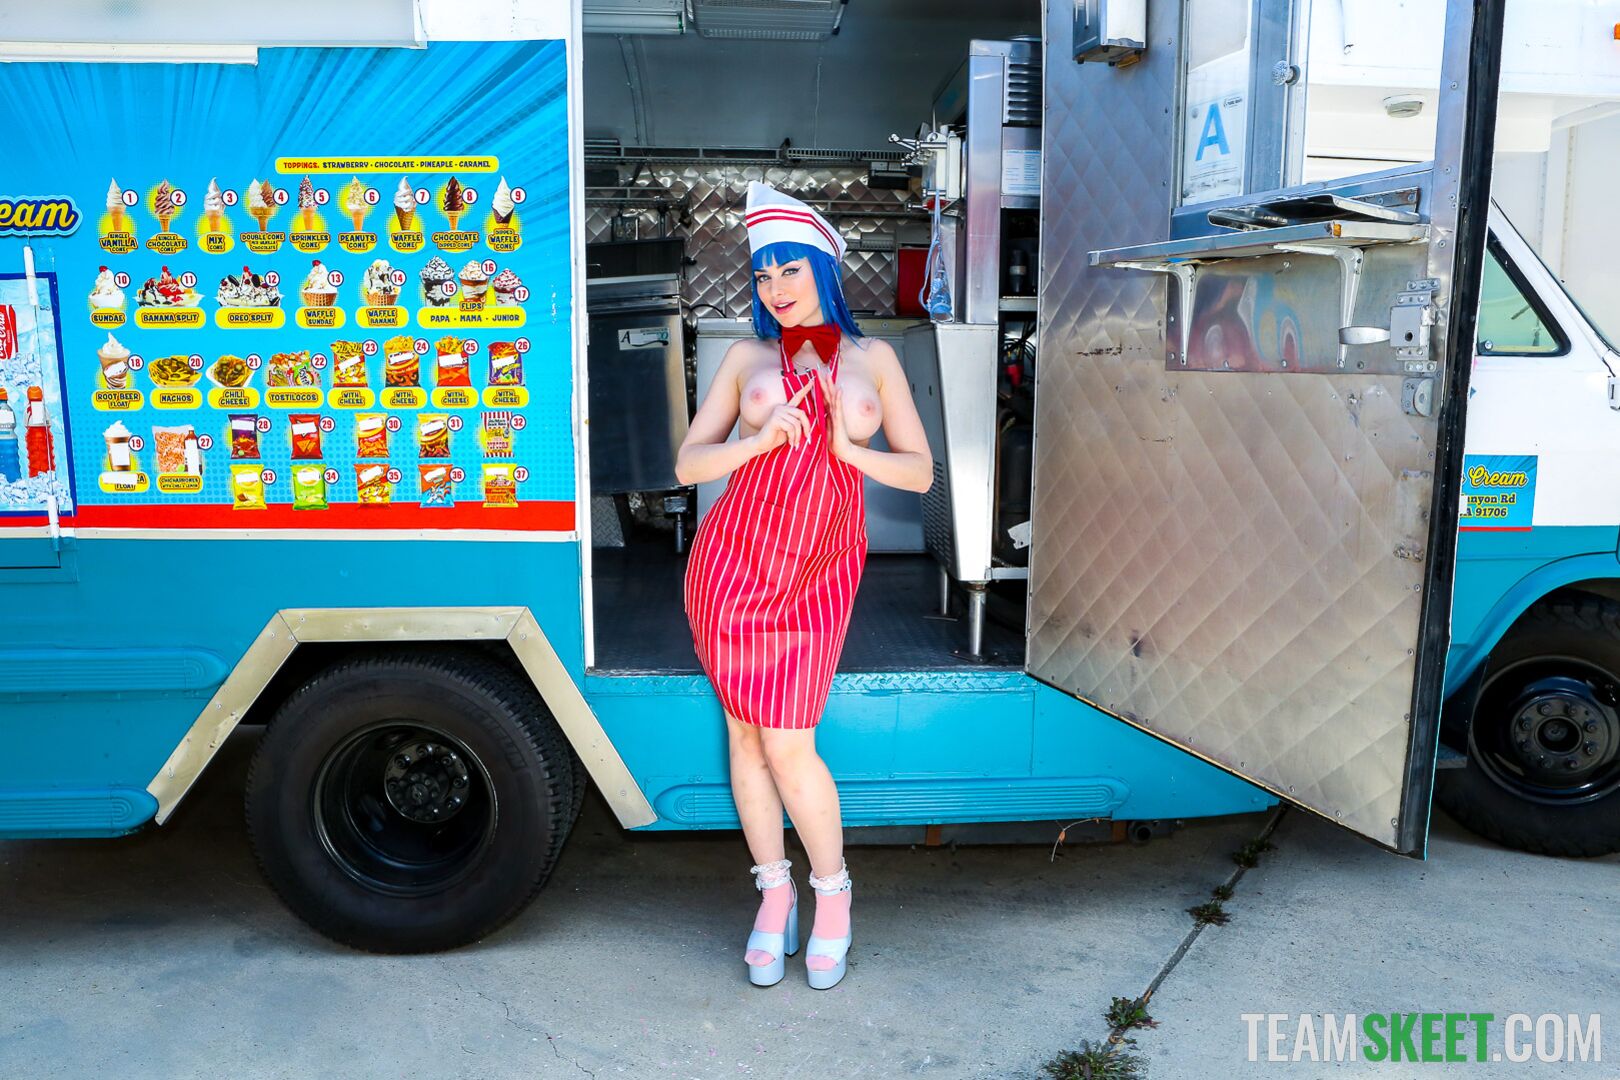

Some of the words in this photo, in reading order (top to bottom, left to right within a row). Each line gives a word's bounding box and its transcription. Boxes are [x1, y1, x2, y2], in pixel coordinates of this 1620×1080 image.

[1195, 103, 1230, 161] A
[127, 193, 132, 203] 1
[175, 193, 182, 203] 2
[227, 193, 233, 203] 3
[278, 192, 284, 202] 4
[319, 192, 325, 202] 5
[369, 192, 375, 202] 6
[420, 191, 425, 201] 7
[467, 191, 473, 201] 8
[515, 191, 521, 200] 9
[101, 239, 136, 247] VANILLA
[208, 236, 223, 244] MIX
[484, 263, 494, 272] 16
[117, 275, 127, 284] 10
[185, 275, 194, 284] 11
[268, 275, 277, 283] 12
[331, 274, 341, 283] 13
[393, 273, 403, 283] 14
[444, 283, 454, 293] 15
[517, 289, 526, 299] 17
[94, 314, 123, 322] SUNDAE
[143, 314, 174, 322] BANANA
[365, 343, 375, 352] 23
[416, 342, 427, 351] 24
[466, 343, 476, 352] 25
[517, 341, 528, 350] 26
[130, 358, 140, 367] 18
[190, 357, 201, 367] 20
[248, 358, 258, 366] 21
[314, 357, 325, 366] 22
[119, 392, 139, 400] BEER
[270, 393, 317, 401] TOSTILOCOS
[258, 420, 268, 429] 28
[322, 420, 332, 429] 29
[388, 420, 398, 428] 30
[450, 419, 459, 428] 31
[514, 418, 523, 427] 32
[131, 439, 141, 448] 19
[200, 438, 210, 447] 27
[263, 472, 273, 481] 33
[326, 472, 336, 480] 34
[389, 471, 399, 480] 35
[452, 470, 462, 479] 36
[516, 470, 526, 479] 37
[1468, 466, 1526, 486] Cream
[1501, 494, 1515, 503] Rd
[1475, 507, 1507, 517] 91706
